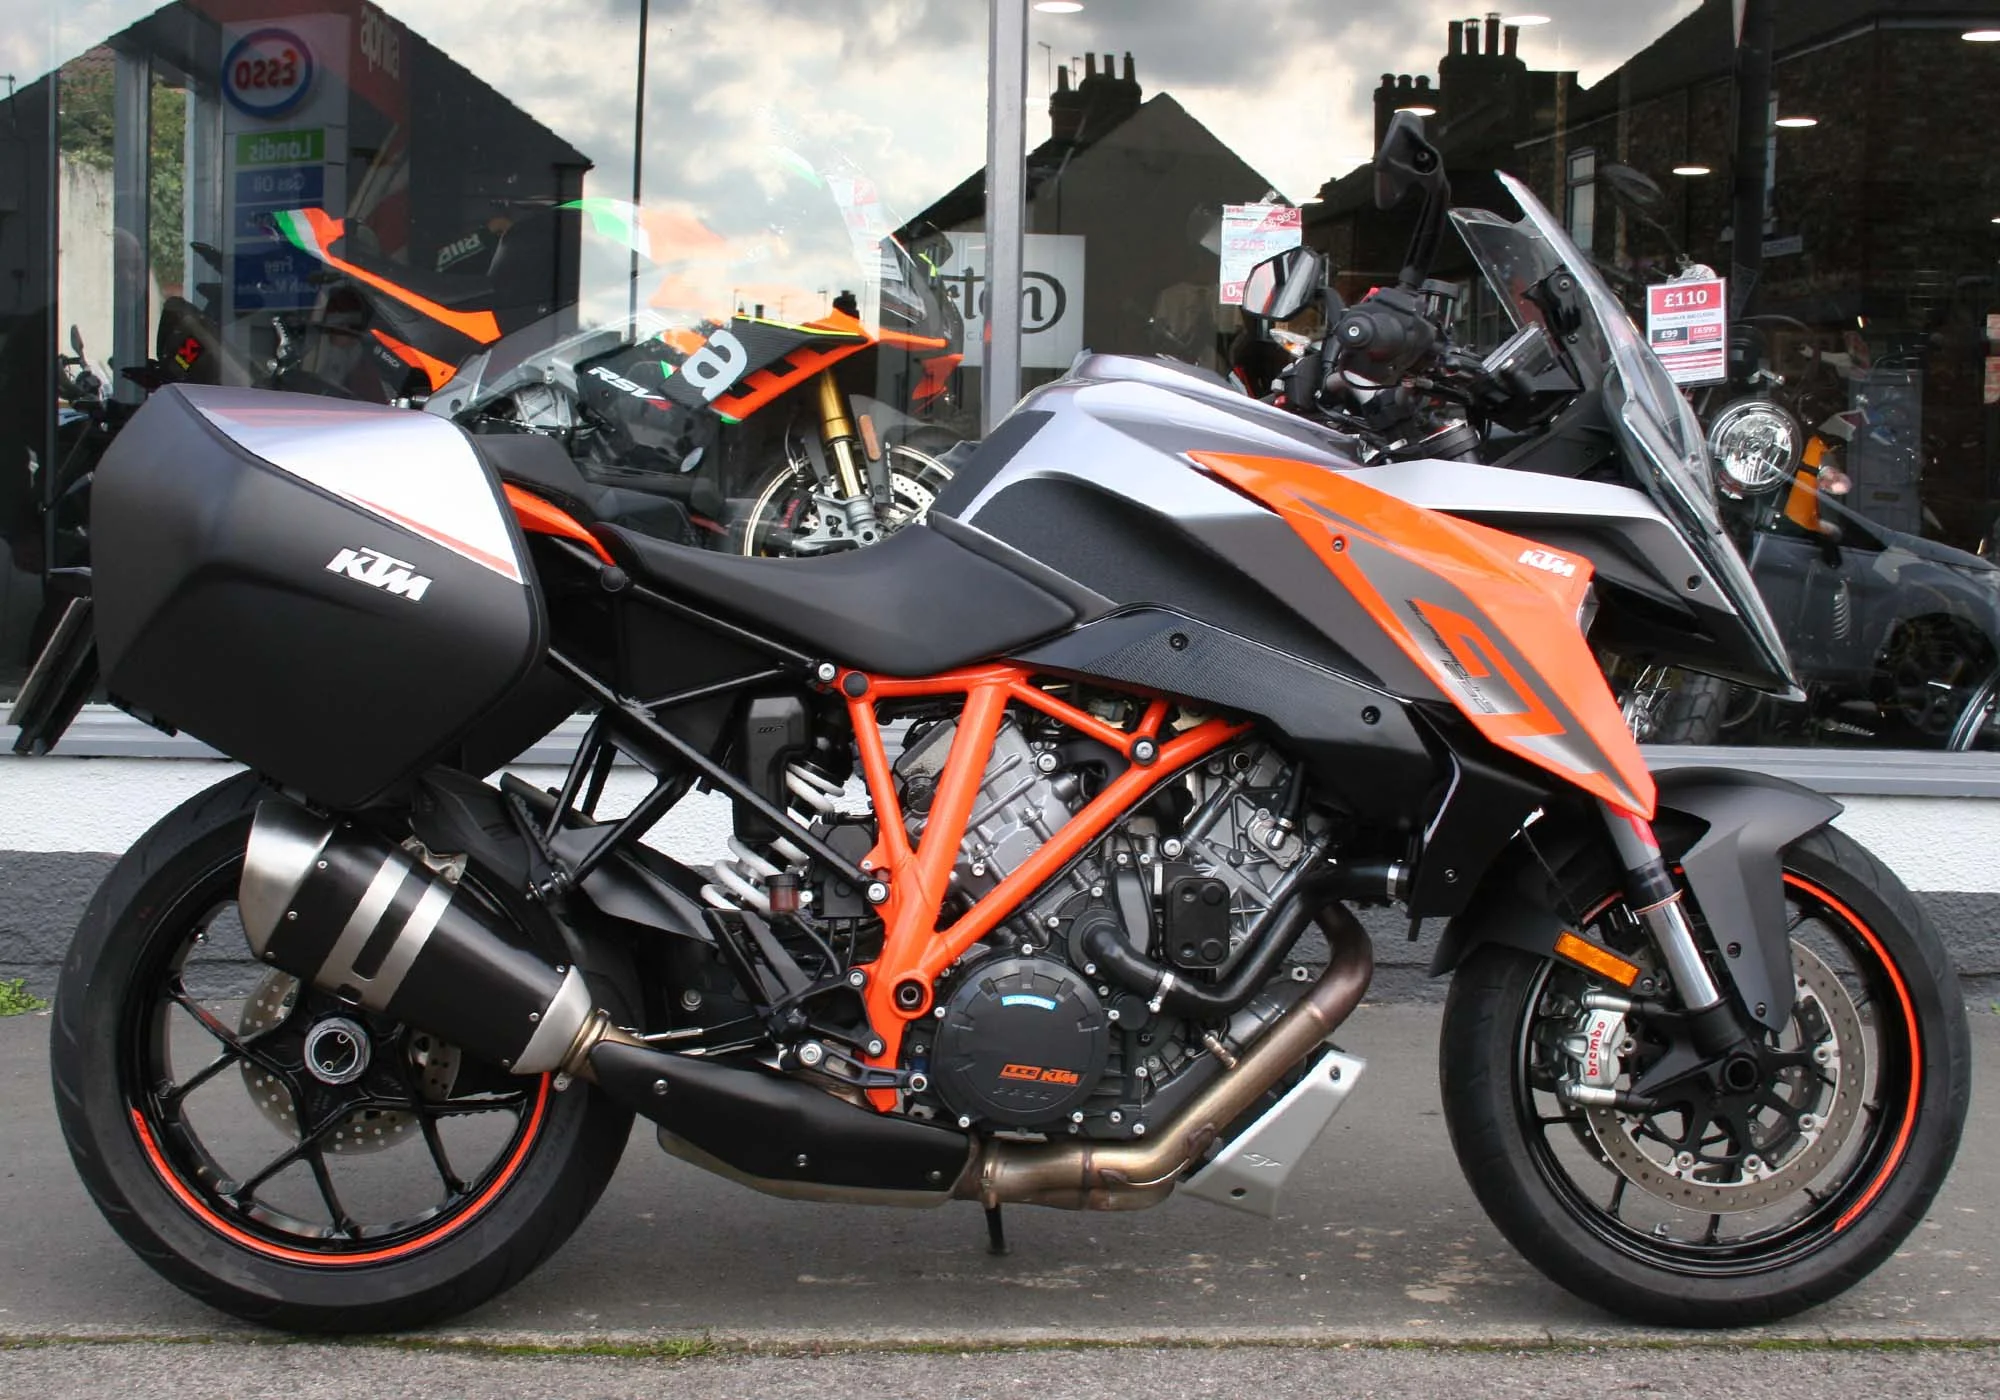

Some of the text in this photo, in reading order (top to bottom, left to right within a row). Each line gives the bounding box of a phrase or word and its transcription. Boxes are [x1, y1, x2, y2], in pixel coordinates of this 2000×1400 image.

[1664, 290, 1707, 307] £110
[326, 547, 432, 601] KTM
[1518, 549, 1576, 577] KTM
[1587, 1021, 1605, 1076] brembo
[1041, 1069, 1079, 1085] KTM
